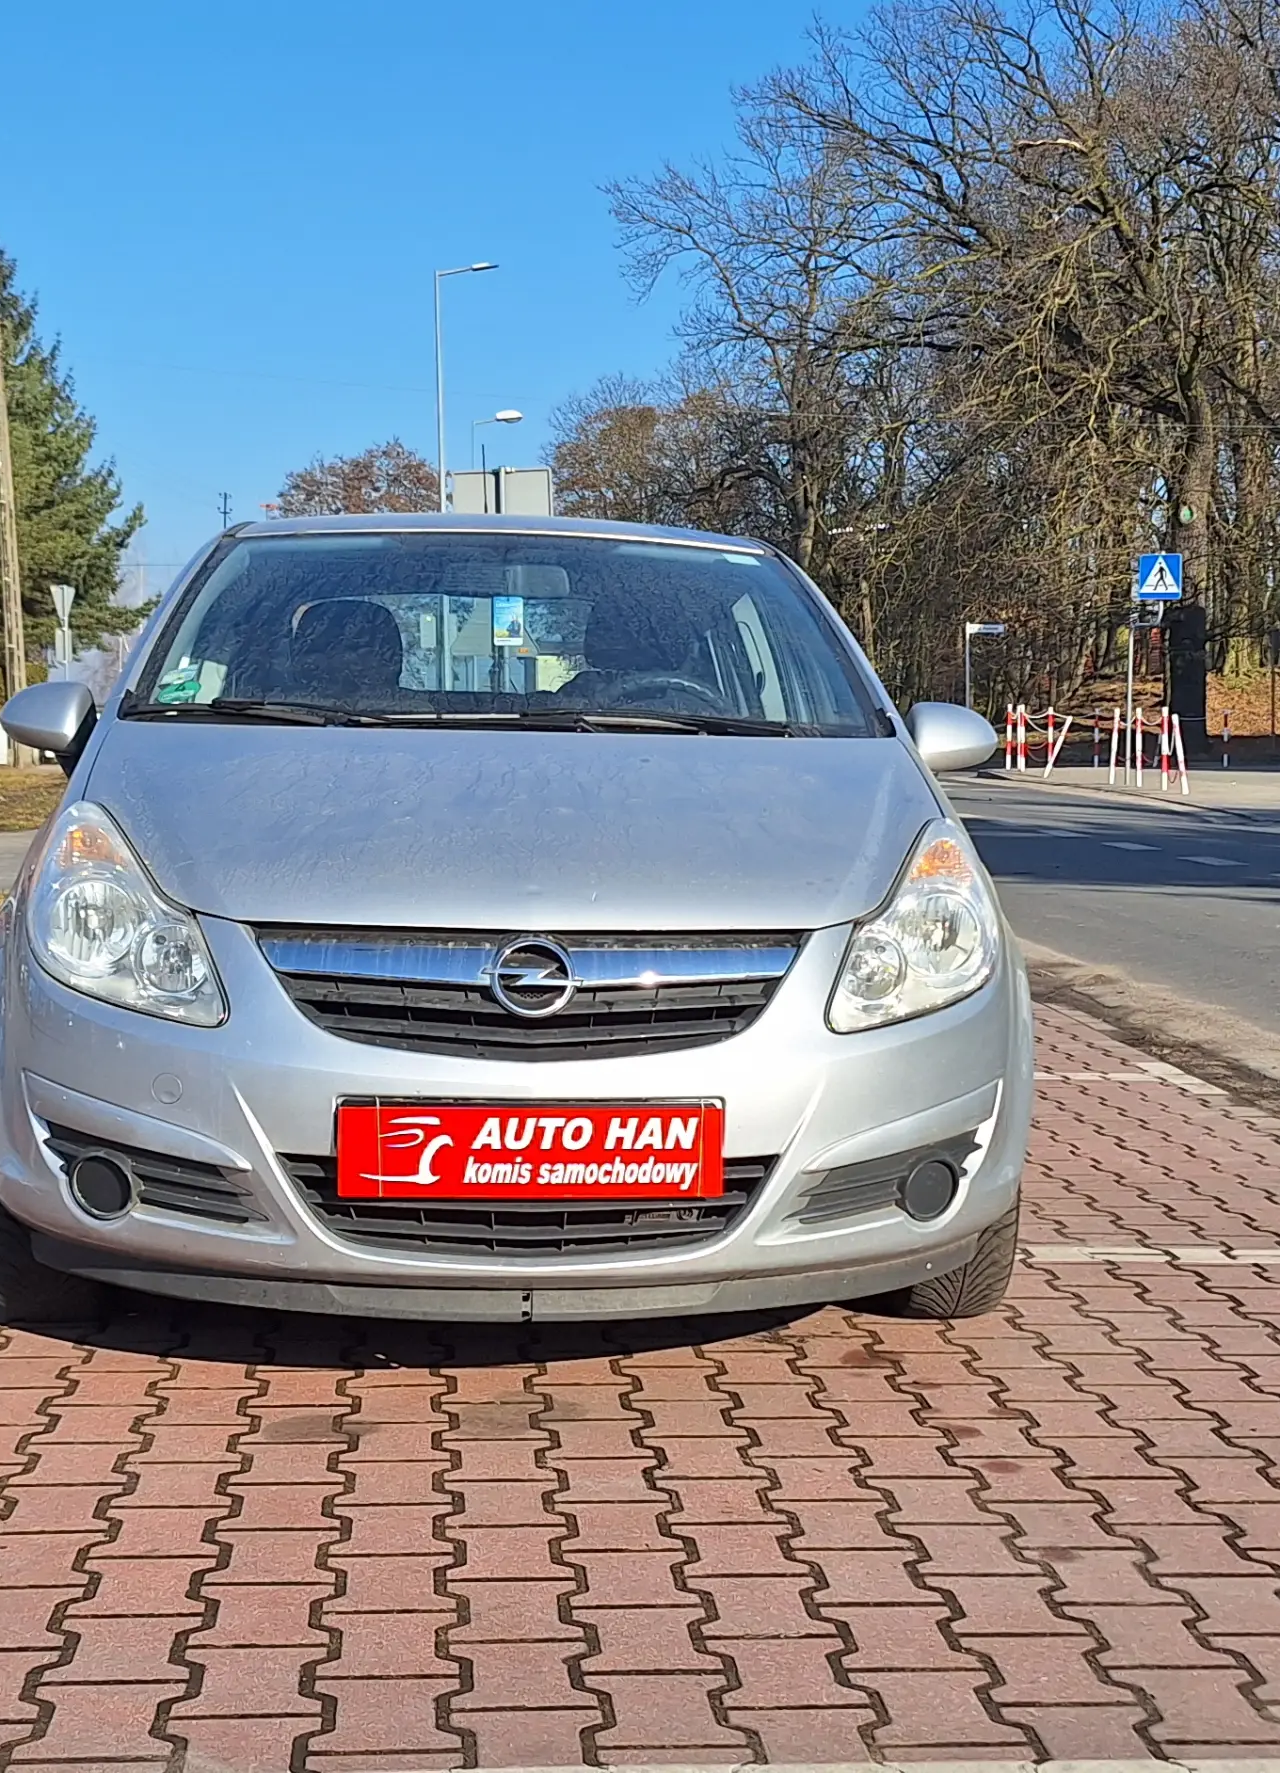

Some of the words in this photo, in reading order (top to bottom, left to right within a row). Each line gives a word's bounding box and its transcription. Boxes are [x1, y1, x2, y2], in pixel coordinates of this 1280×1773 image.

[470, 1117, 594, 1150] AUTO
[603, 1117, 700, 1150] HAN
[462, 1155, 532, 1184] komis
[536, 1155, 699, 1191] samochodowy
